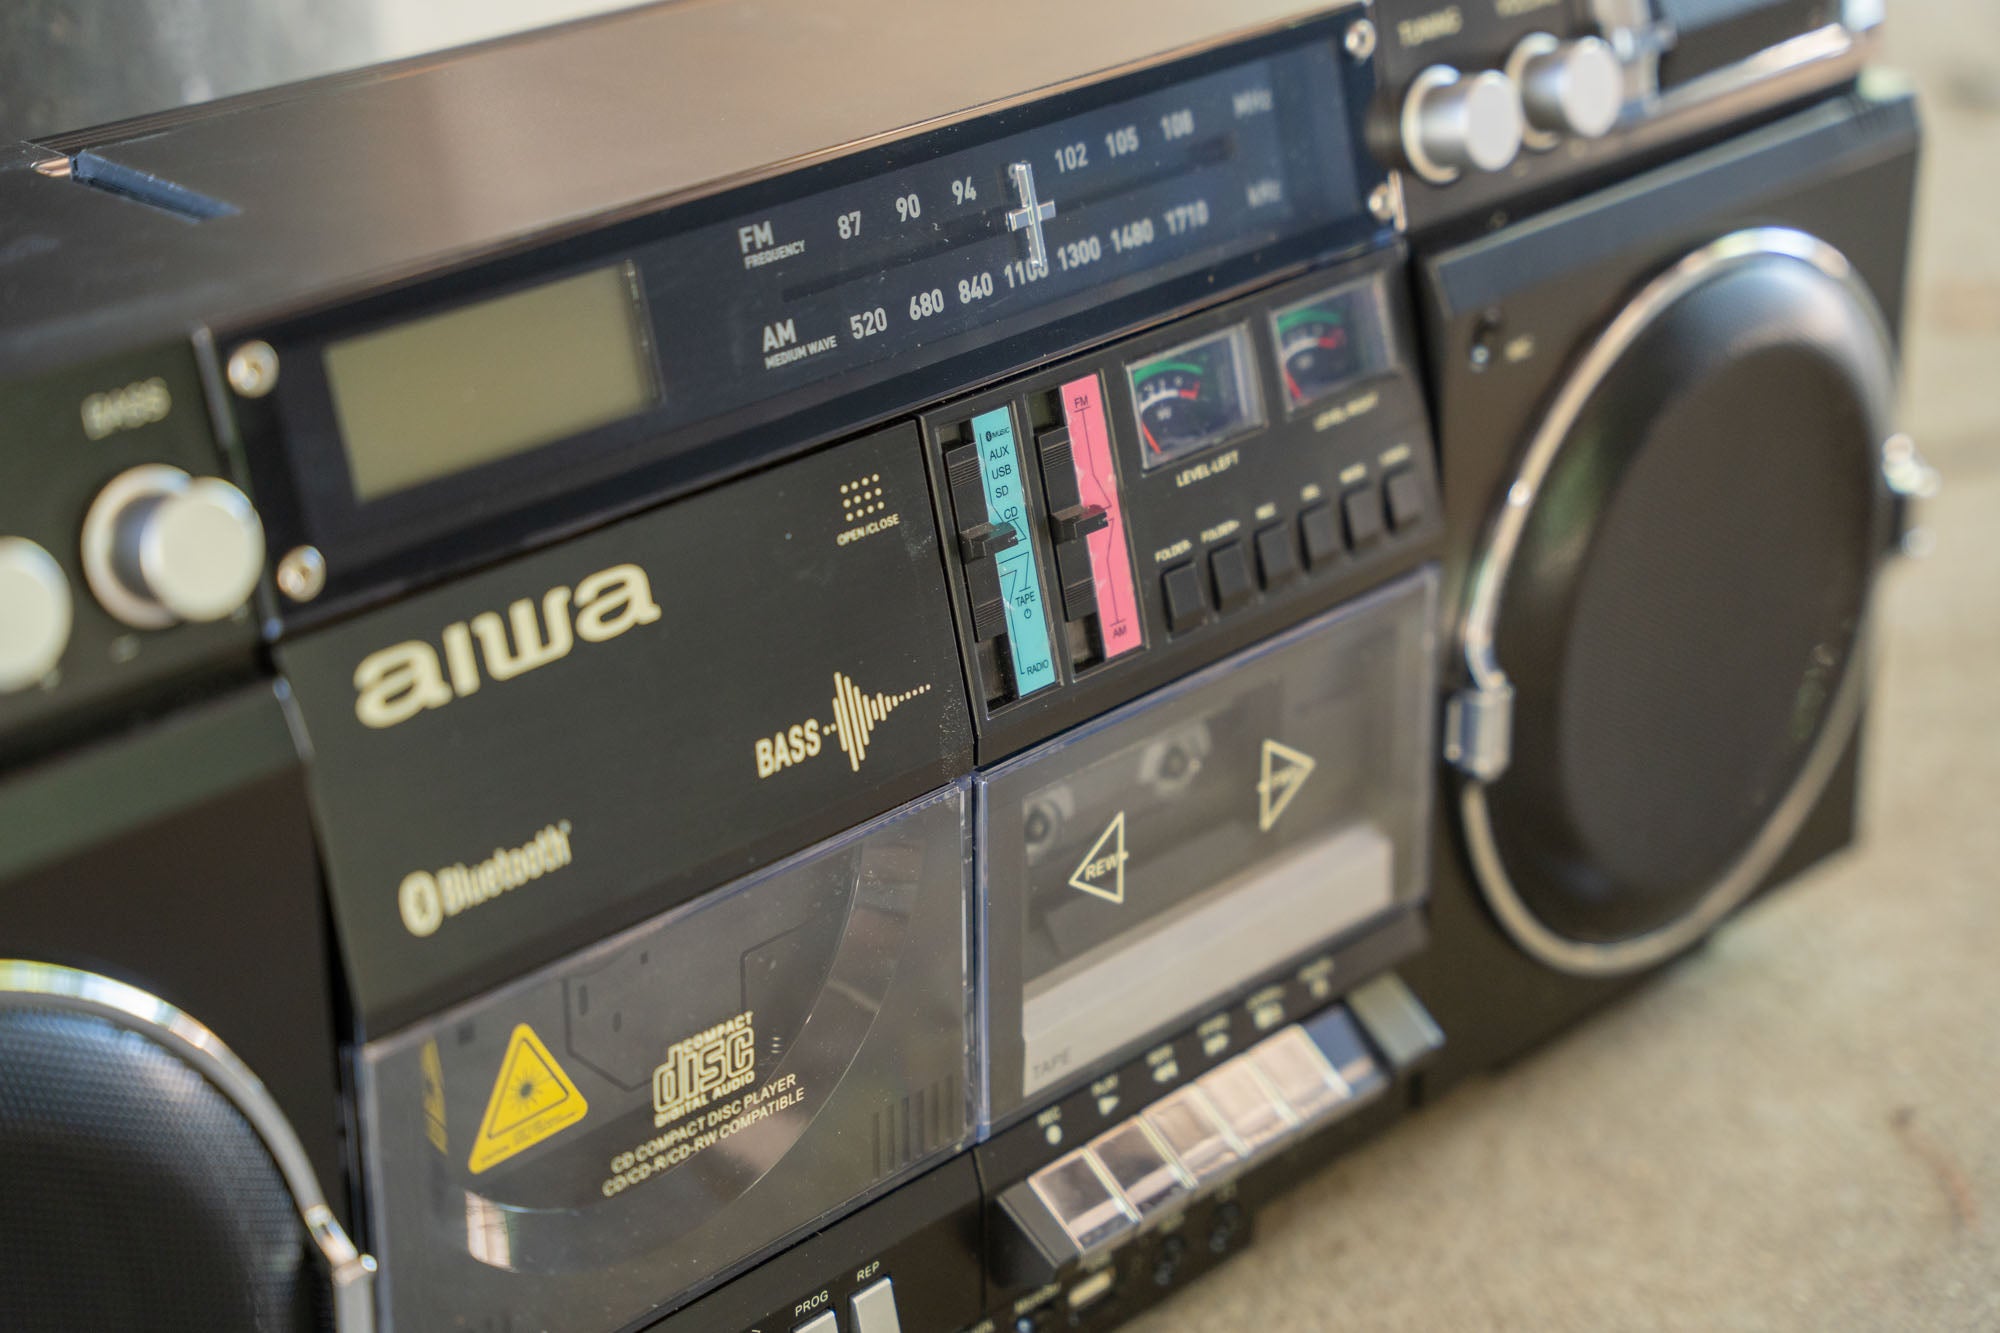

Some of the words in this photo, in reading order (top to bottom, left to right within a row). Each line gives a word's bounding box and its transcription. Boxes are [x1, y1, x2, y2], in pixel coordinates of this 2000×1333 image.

[738, 220, 775, 254] FM
[837, 210, 862, 240] 87
[895, 194, 921, 222] 90
[952, 175, 977, 205] 94
[1054, 143, 1089, 173] 102
[1105, 126, 1139, 159] 105
[1160, 108, 1195, 141] 108
[744, 240, 806, 270] FREQUENCY
[762, 318, 798, 353] AM
[850, 307, 888, 340] 520
[909, 288, 944, 321] 680
[957, 272, 994, 304] 840
[1057, 235, 1102, 272] 1300
[1163, 199, 1209, 236] 1710
[764, 345, 808, 370] MEDIUM
[807, 335, 838, 356] WAVE
[1073, 394, 1090, 408] FM
[991, 426, 1011, 438] MUSIC
[989, 445, 1010, 461] AUX
[991, 464, 1012, 480] USB
[995, 485, 1009, 499] SD
[1003, 506, 1018, 520] CD
[836, 513, 900, 547] OPEN/CLOSE
[1014, 591, 1036, 610] TAPE
[352, 562, 663, 729] aiwa
[1112, 625, 1127, 639] AM
[1026, 659, 1050, 677] RADIO
[754, 717, 822, 780] BASS
[438, 824, 573, 918] Bluetooth
[682, 1010, 755, 1055] COMPACT
[654, 1095, 710, 1129] DIGITAL
[711, 1070, 756, 1099] AUDIO
[610, 1149, 637, 1174] CD
[636, 1117, 707, 1166] COMPACT
[706, 1100, 746, 1127] DISC
[742, 1073, 797, 1111] PLAYER
[600, 1128, 718, 1199] CD/CD-R/CD-RW
[718, 1087, 806, 1142] COMPATIBLE
[856, 1260, 881, 1283] REP
[795, 1290, 829, 1317] PROG
